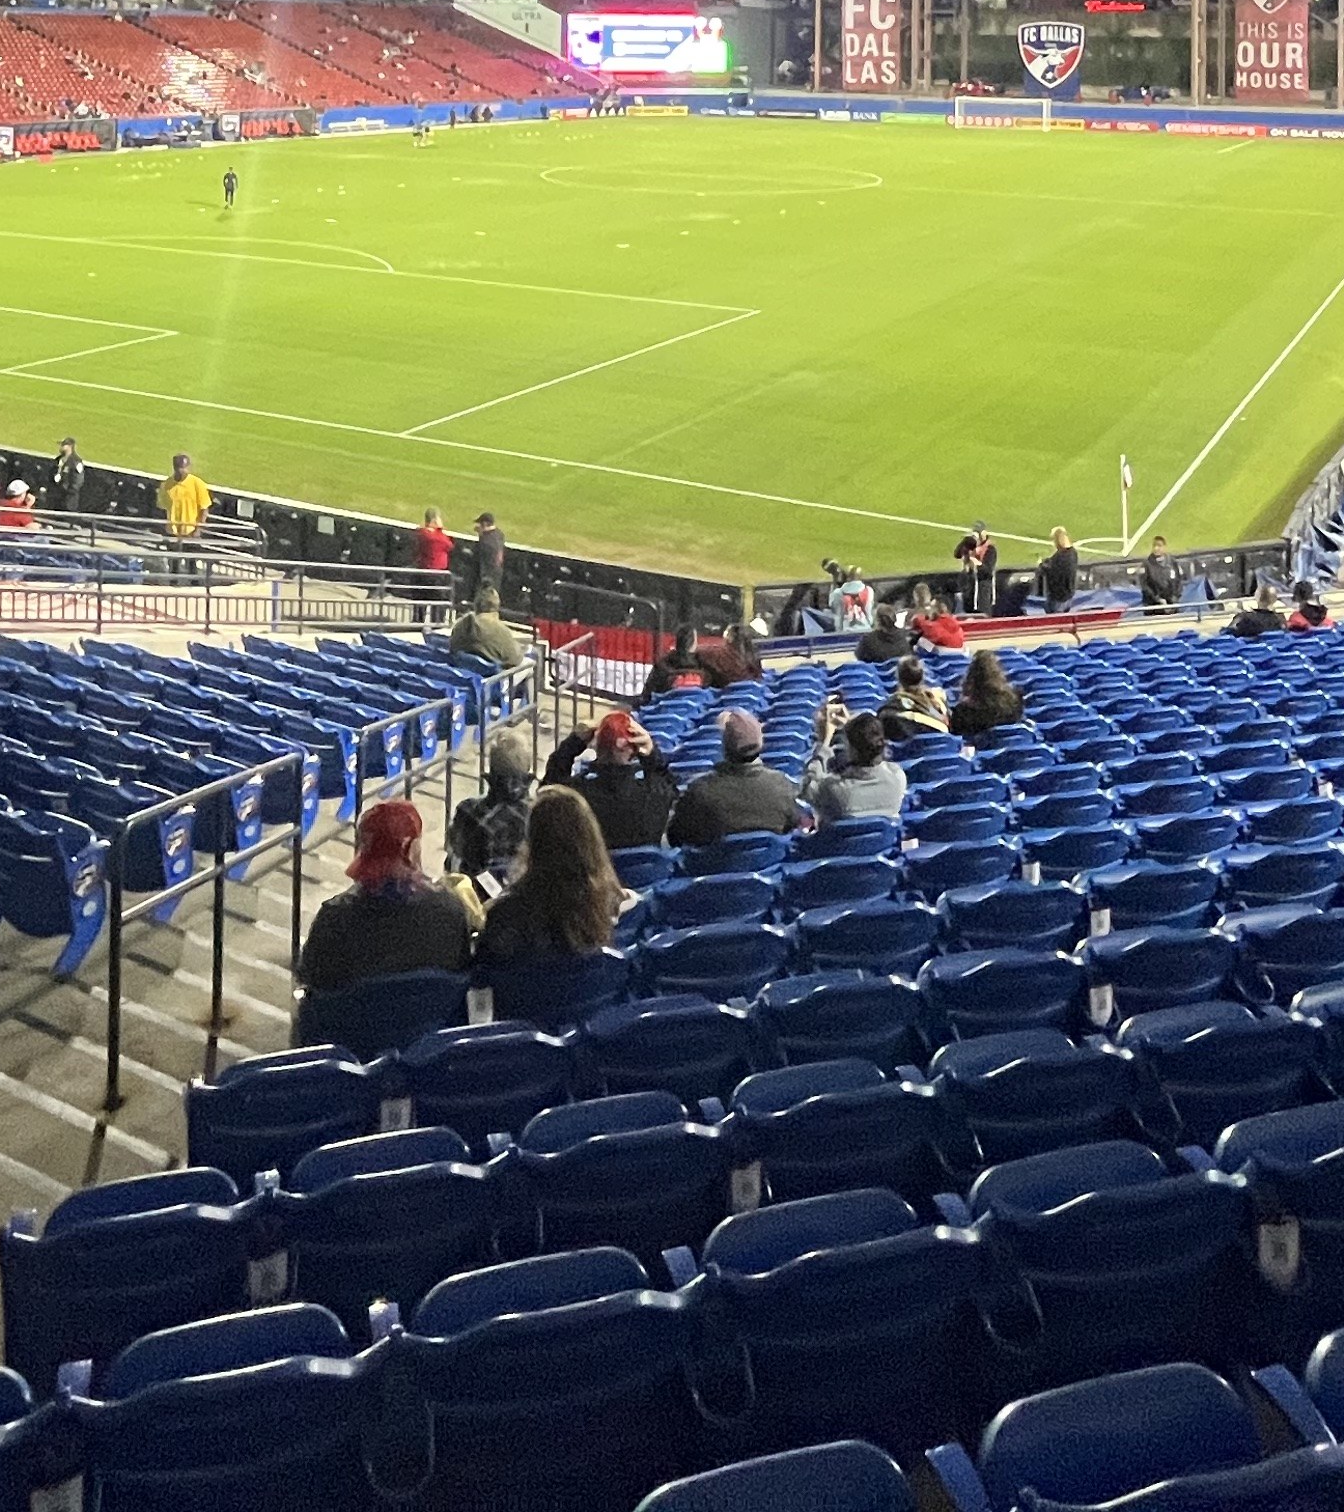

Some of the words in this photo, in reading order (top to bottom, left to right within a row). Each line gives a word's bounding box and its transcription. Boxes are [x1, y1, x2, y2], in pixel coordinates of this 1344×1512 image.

[1023, 27, 1037, 43] FC
[1039, 26, 1080, 43] DALLAS
[1239, 21, 1278, 39] THIS
[1287, 22, 1304, 39] IS
[845, 33, 896, 57] DAL
[1237, 41, 1303, 68] OUR
[845, 60, 896, 84] LAS
[1236, 72, 1305, 89] HOUSE
